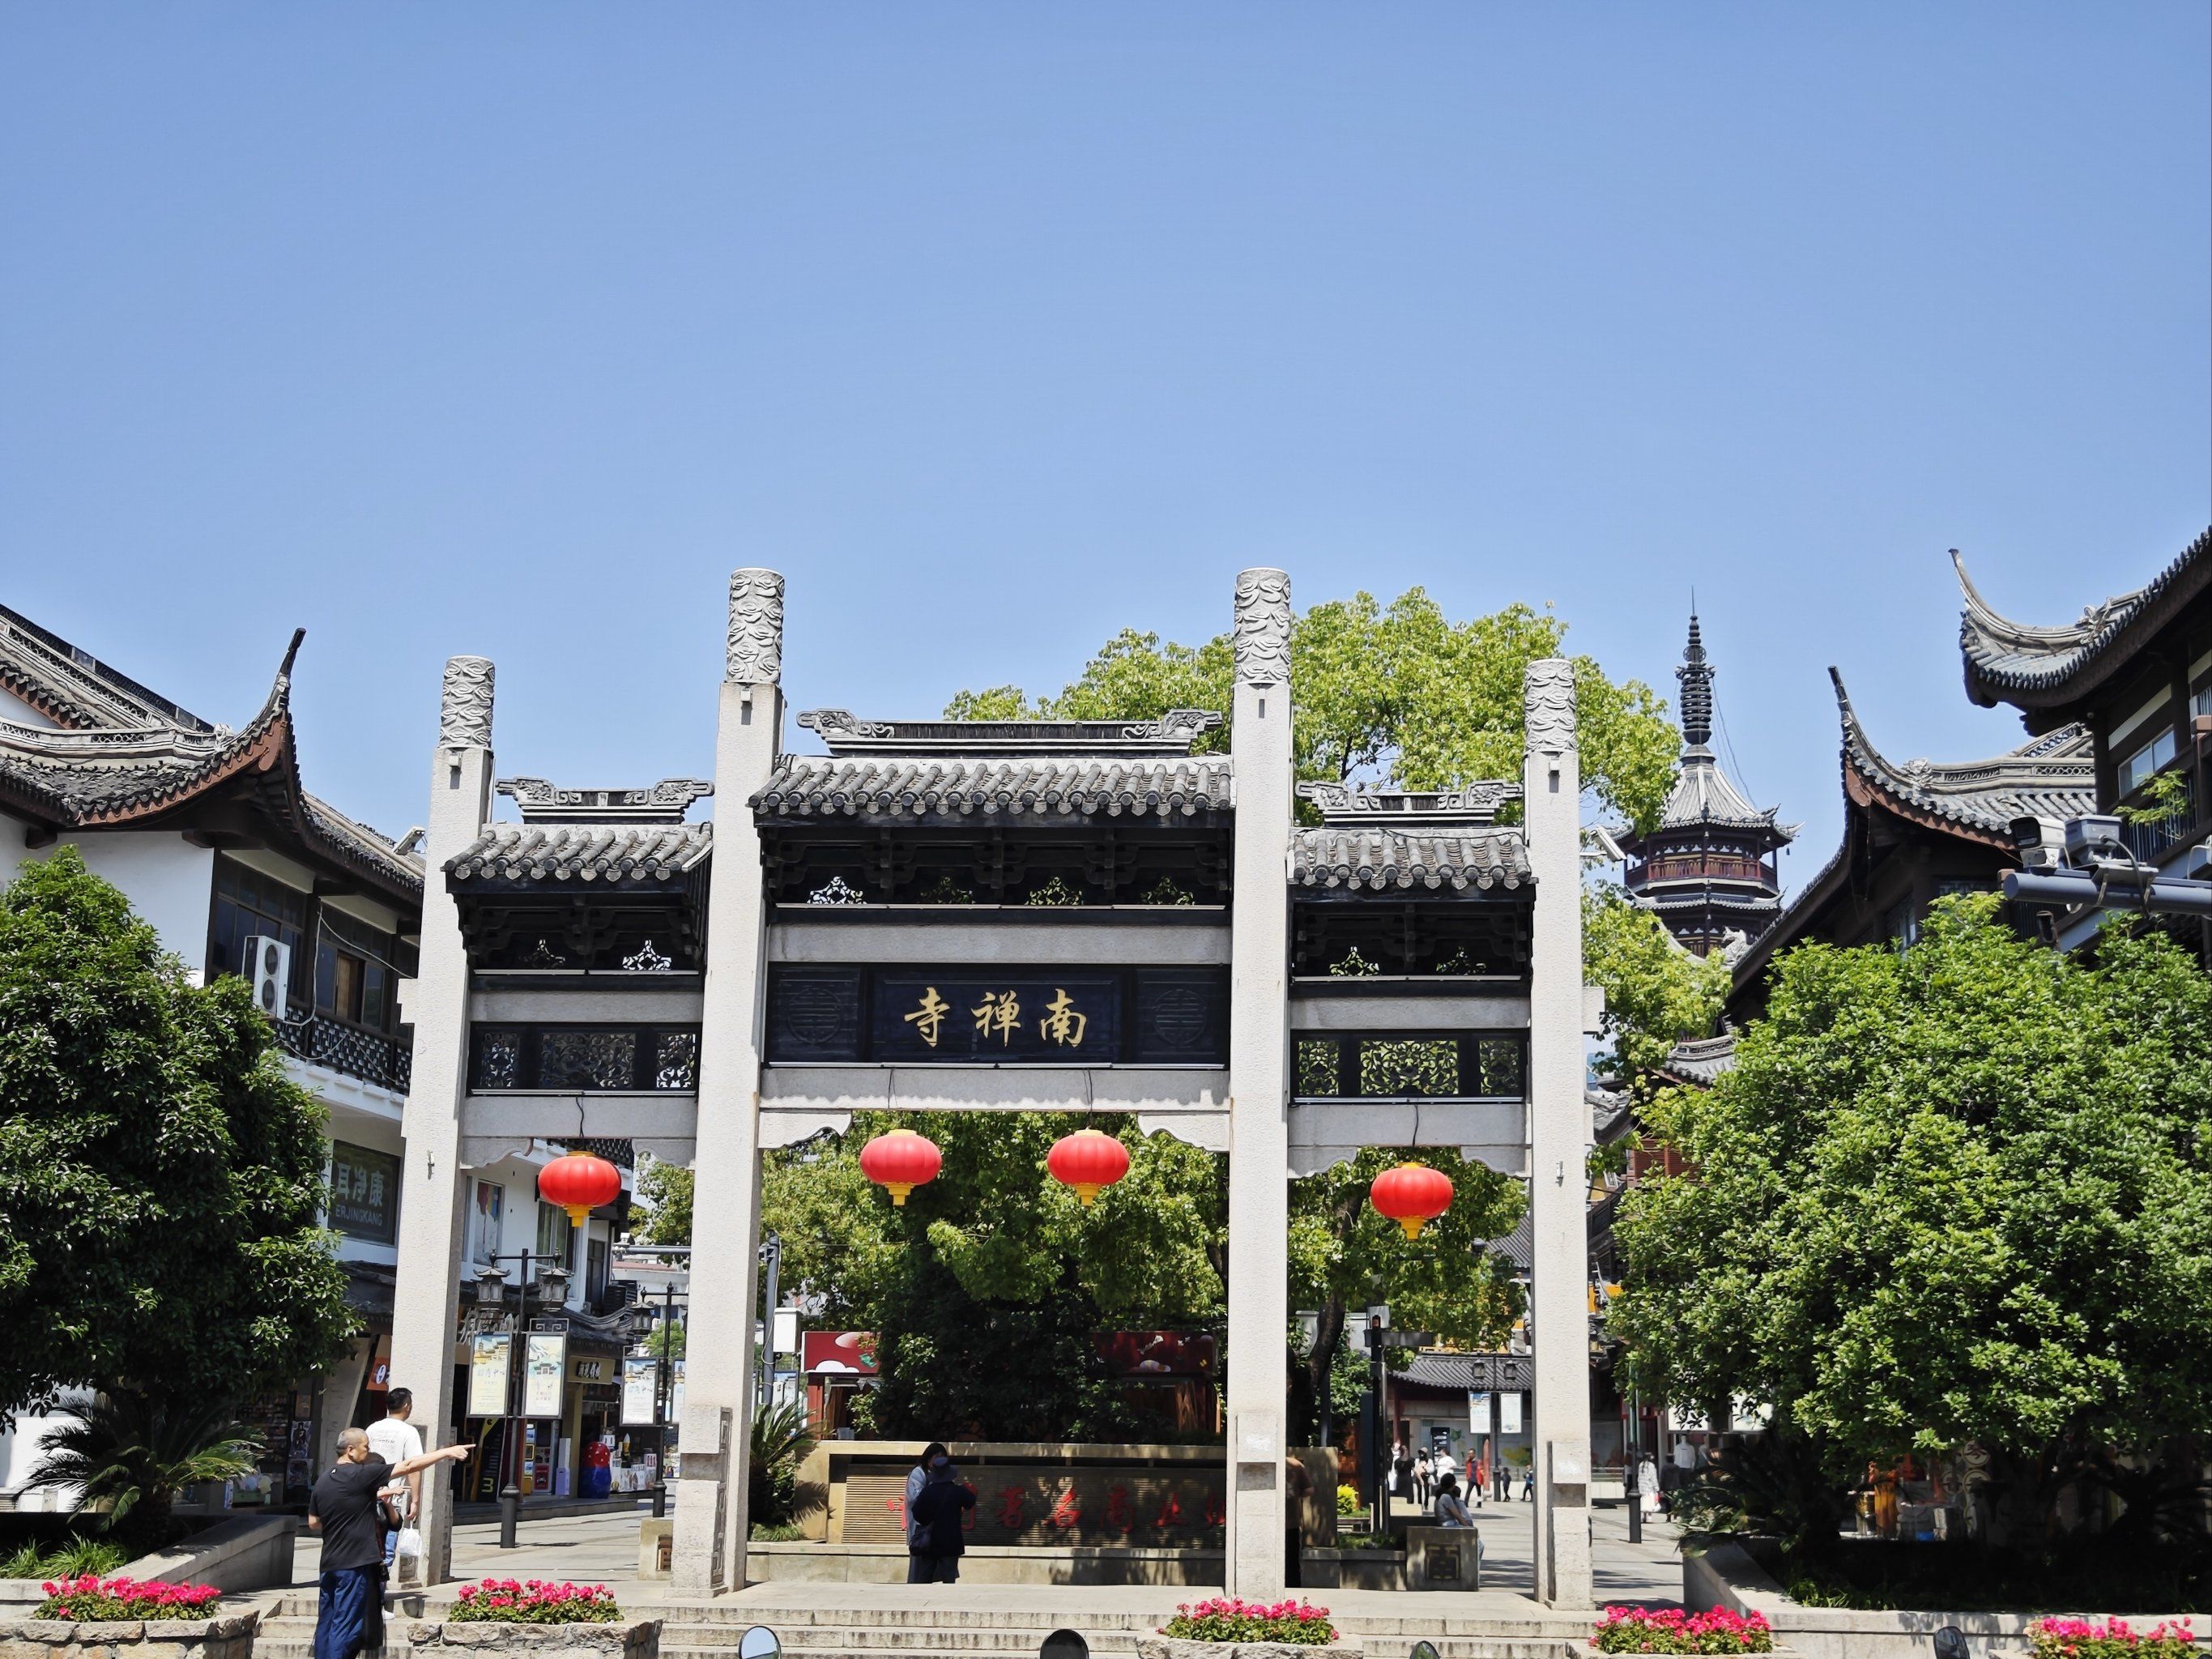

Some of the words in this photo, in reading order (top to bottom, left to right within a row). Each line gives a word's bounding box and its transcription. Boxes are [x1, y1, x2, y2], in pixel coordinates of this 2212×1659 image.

[336, 1162, 384, 1207] 耳净康
[335, 1204, 382, 1226] ERJINGKANG
